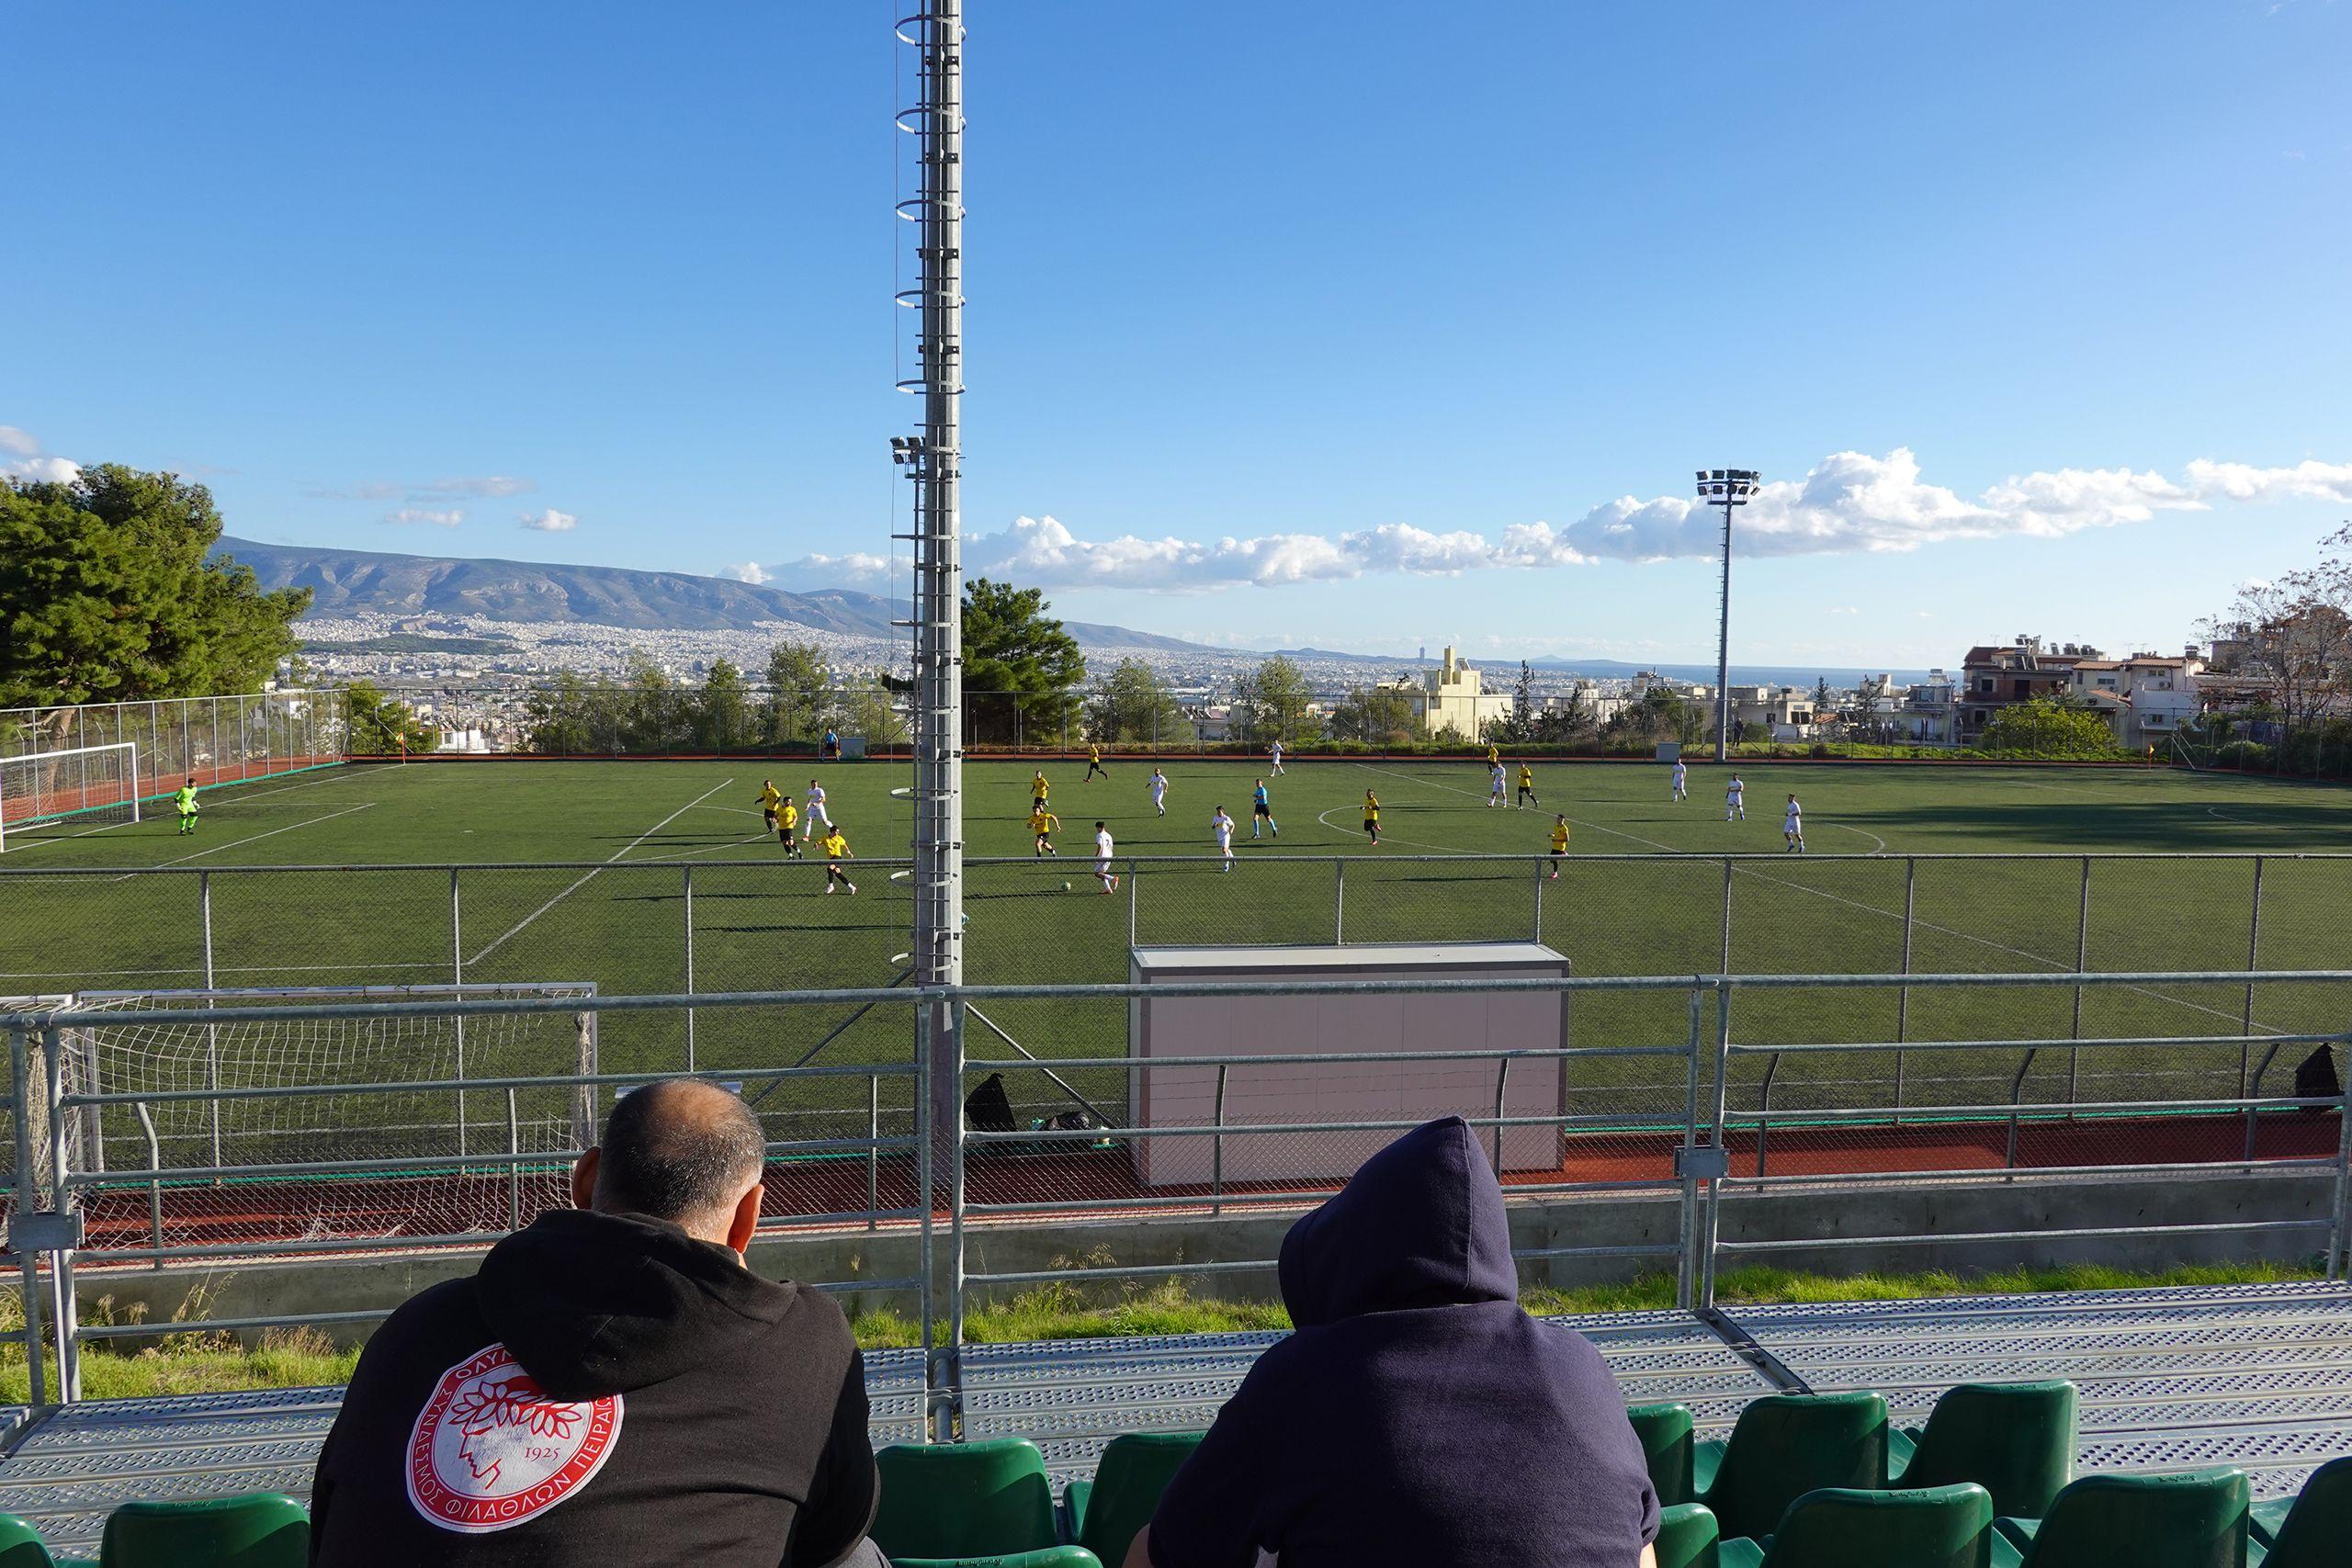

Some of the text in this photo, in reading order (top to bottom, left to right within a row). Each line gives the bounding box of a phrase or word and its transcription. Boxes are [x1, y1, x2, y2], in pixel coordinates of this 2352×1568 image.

[414, 1387, 453, 1506] ΣΥΝΔΕΣΜΟΣ
[446, 1472, 571, 1520] ΦΙΛΑΘΛΩΝ
[524, 1447, 560, 1462] 1925
